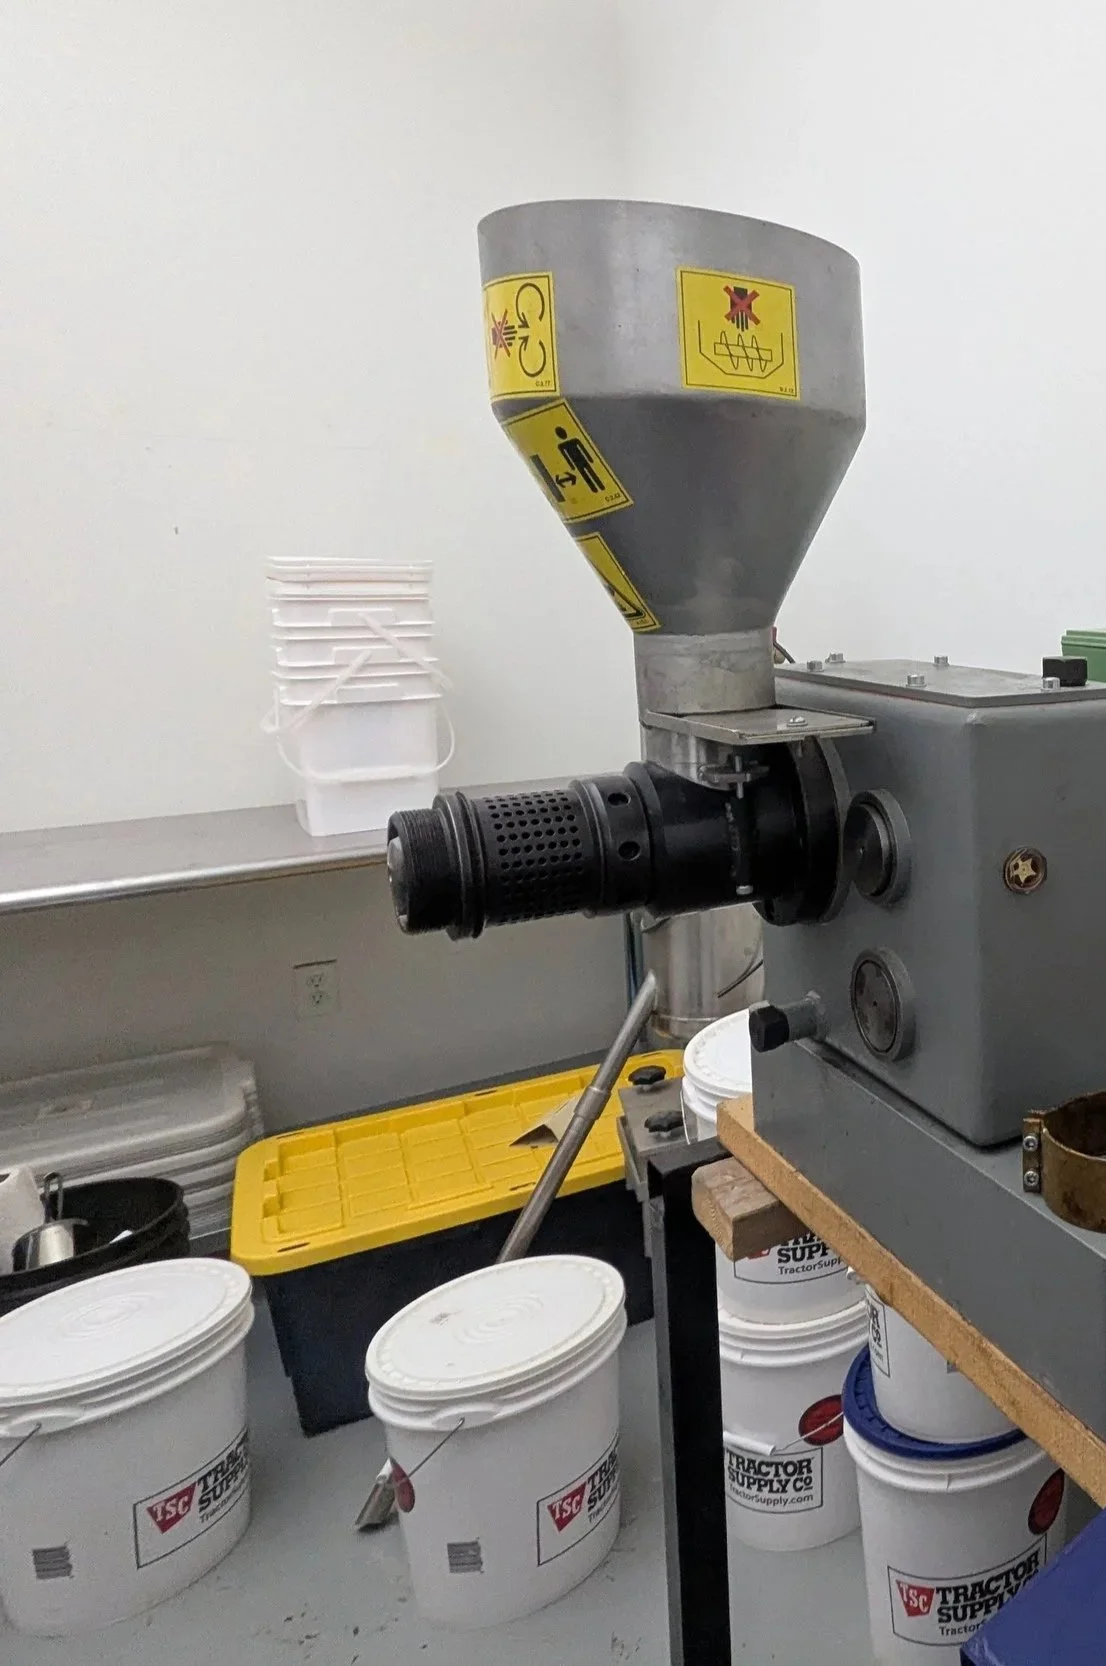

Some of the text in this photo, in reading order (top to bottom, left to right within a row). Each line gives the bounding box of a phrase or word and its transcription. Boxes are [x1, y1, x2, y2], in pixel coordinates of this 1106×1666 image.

[726, 1448, 814, 1478] TRACTOR
[728, 1465, 791, 1494] SUPPLY
[152, 1495, 191, 1522] TSC
[552, 1494, 581, 1521] TSC
[936, 1550, 1040, 1605] TRACTOR
[901, 1583, 928, 1613] TSC
